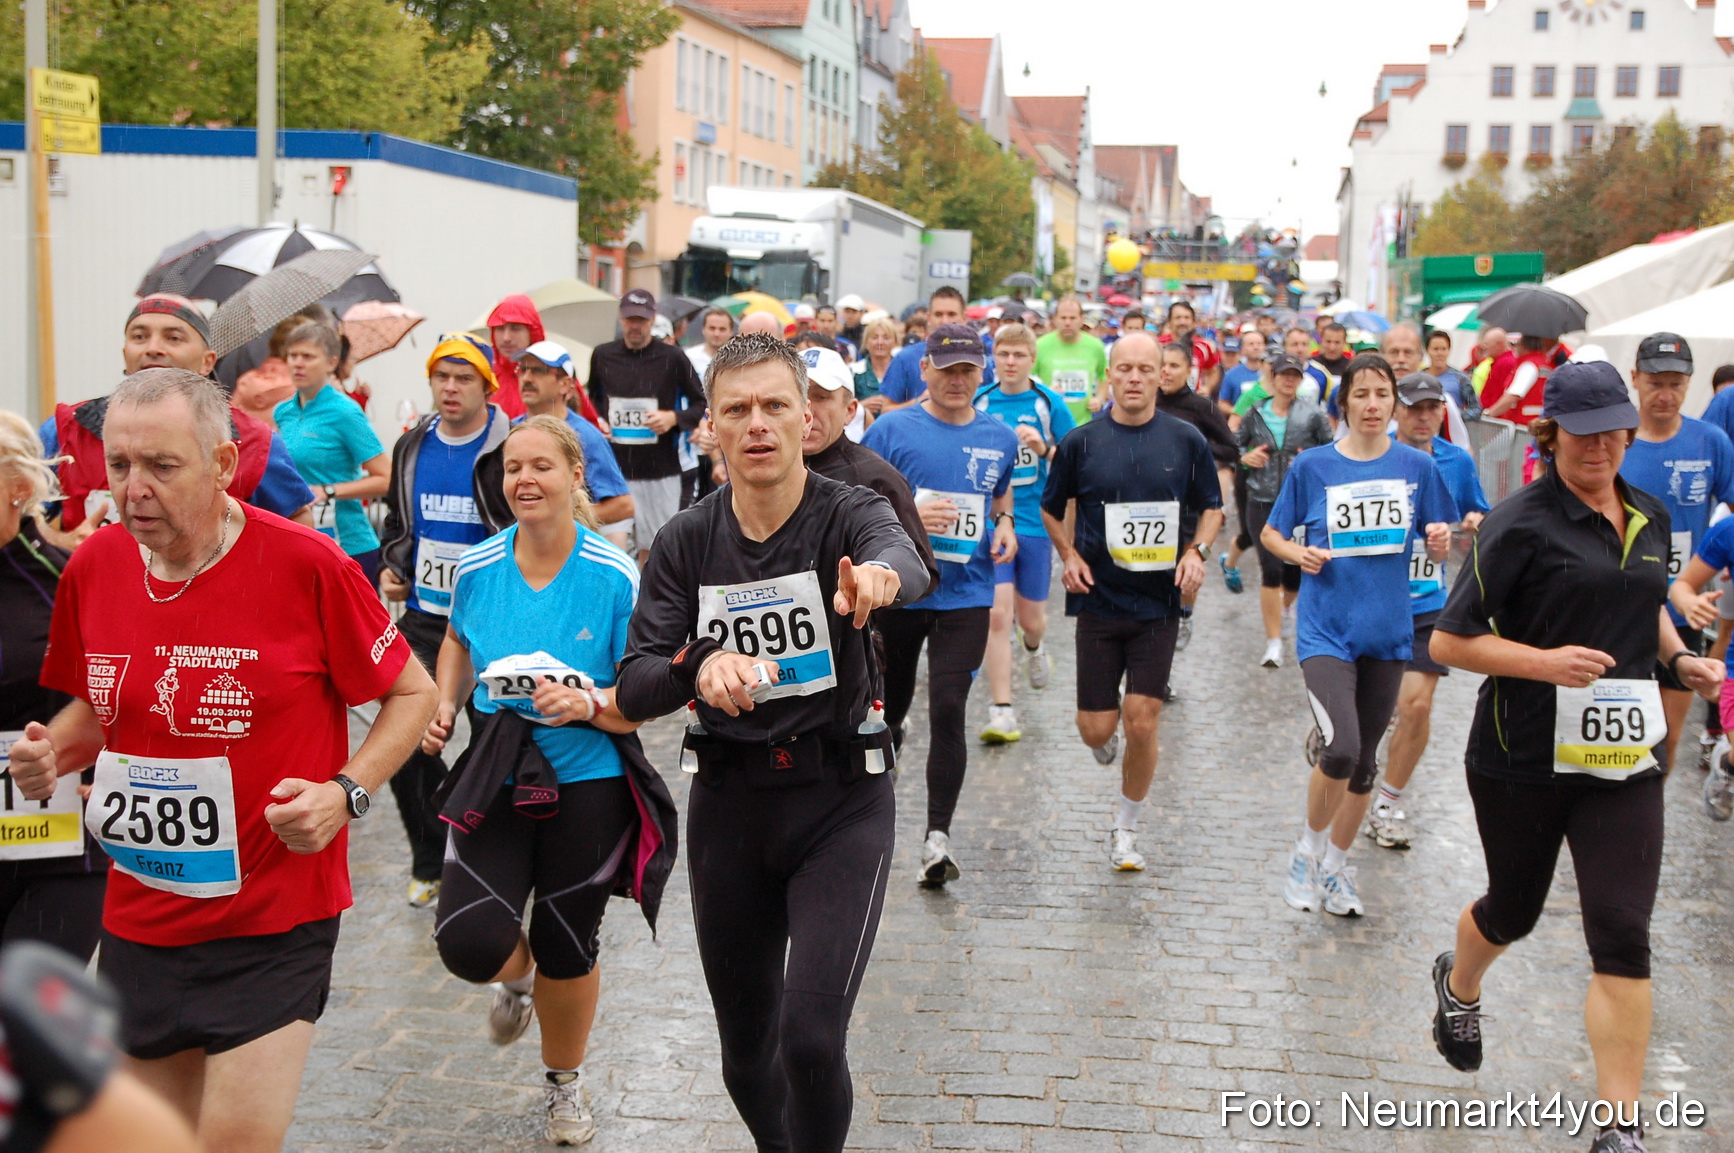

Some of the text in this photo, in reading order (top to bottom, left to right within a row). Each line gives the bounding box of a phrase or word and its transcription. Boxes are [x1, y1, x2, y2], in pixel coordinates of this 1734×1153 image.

[613, 410, 650, 427] 343
[1336, 500, 1402, 529] 3175
[1122, 521, 1166, 545] 372
[1353, 533, 1388, 545] Kristin
[931, 540, 959, 553] Josef
[1131, 551, 1157, 561] Heiko
[725, 586, 778, 605] BOCK
[708, 606, 816, 658] 2696
[154, 645, 259, 661] 11. NEUMARKTER
[168, 656, 241, 670] STADTLAUF
[1593, 686, 1631, 696] BOCK
[197, 707, 253, 717] 19.09.2010
[1581, 706, 1645, 743] 659
[1584, 751, 1640, 765] martina
[128, 765, 179, 782] BOCK
[101, 791, 219, 847] 2589
[136, 855, 185, 877] Franz
